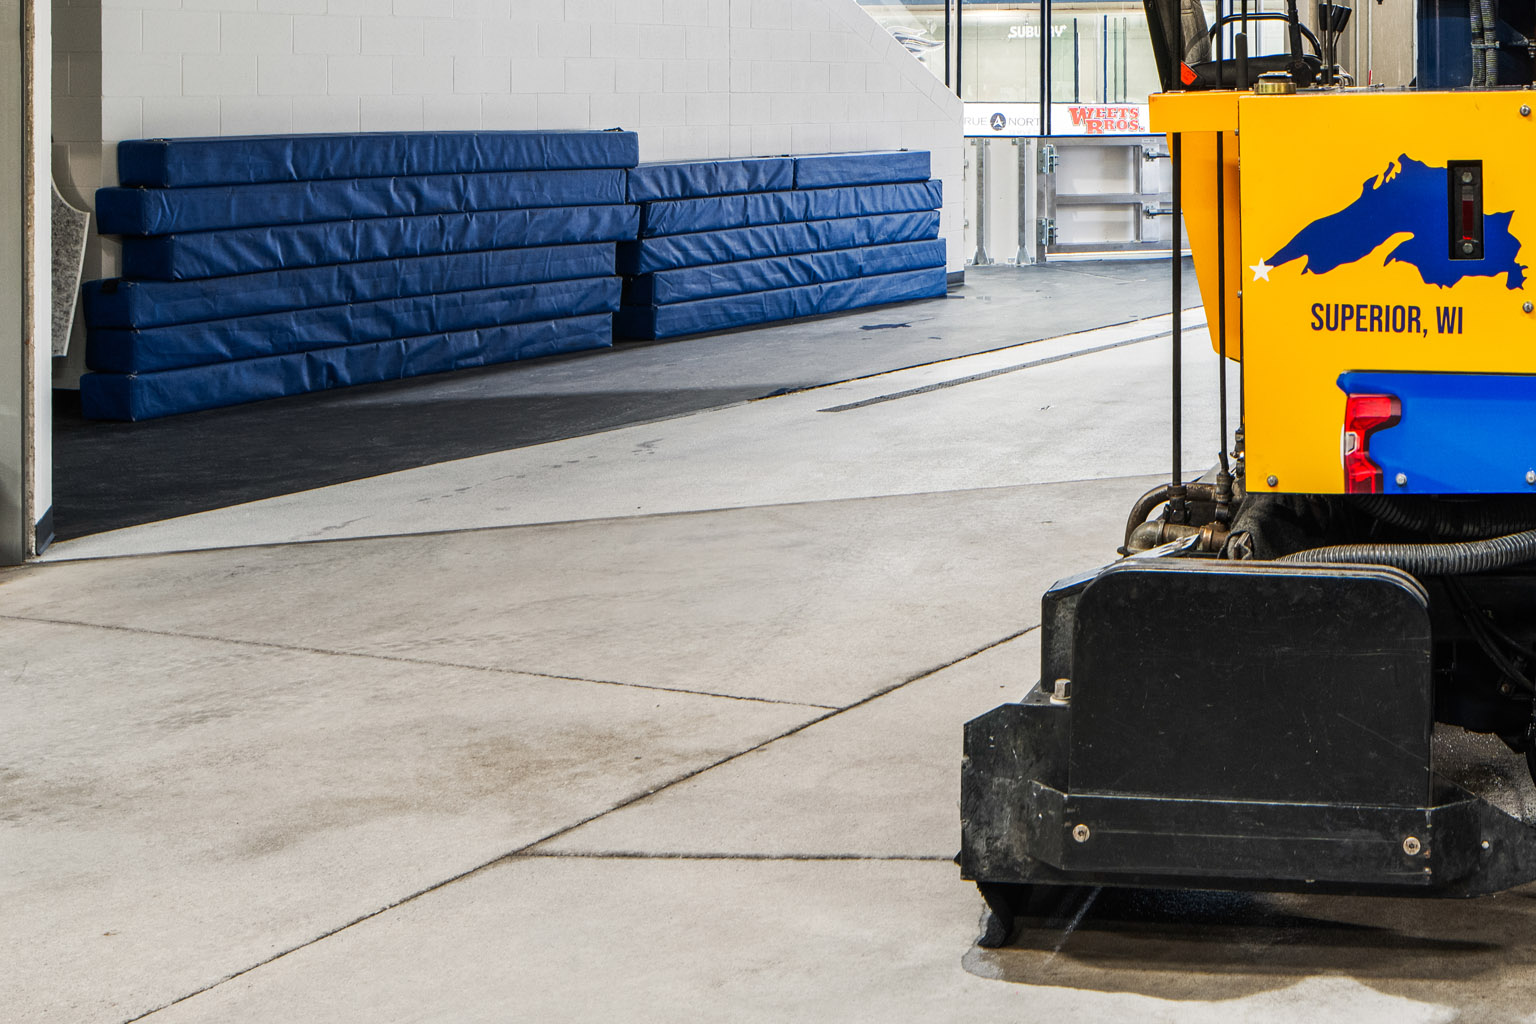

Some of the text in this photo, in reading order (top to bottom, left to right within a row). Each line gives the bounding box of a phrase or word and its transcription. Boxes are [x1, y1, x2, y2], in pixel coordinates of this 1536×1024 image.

[964, 117, 1040, 126] RUE NORT
[1068, 106, 1140, 126] WEETS
[1086, 119, 1145, 134] BROS.
[1310, 303, 1463, 338] SUPERIOR, WI
